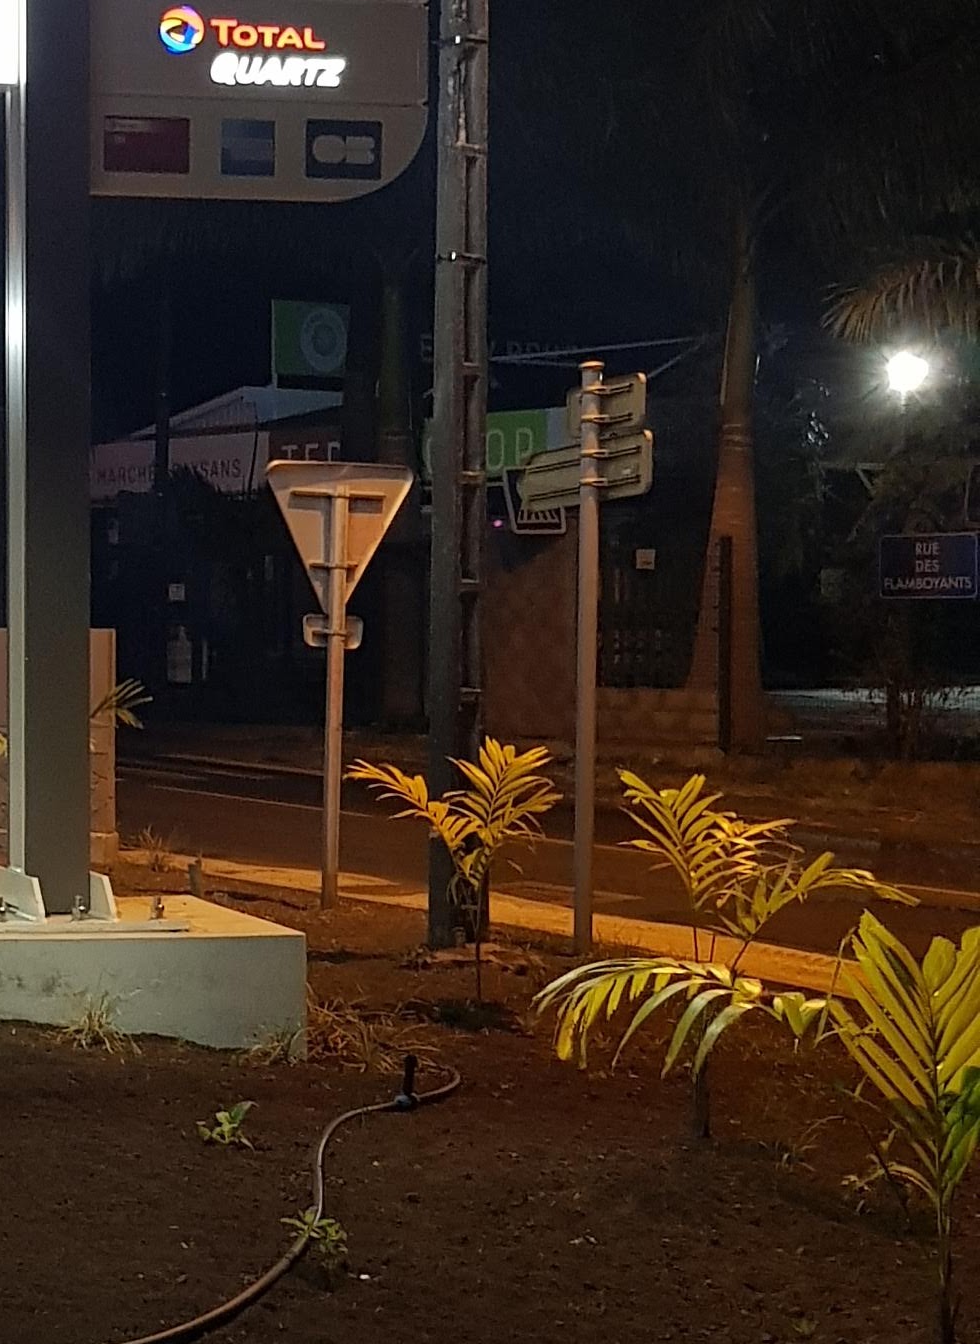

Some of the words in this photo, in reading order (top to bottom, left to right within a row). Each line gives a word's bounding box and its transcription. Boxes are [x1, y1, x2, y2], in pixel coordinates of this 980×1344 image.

[209, 18, 326, 50] TOTAL
[210, 52, 347, 88] QUARTZ
[915, 541, 940, 556] RUE
[915, 559, 940, 573] DES
[883, 575, 973, 590] FLAMBOYANTS
